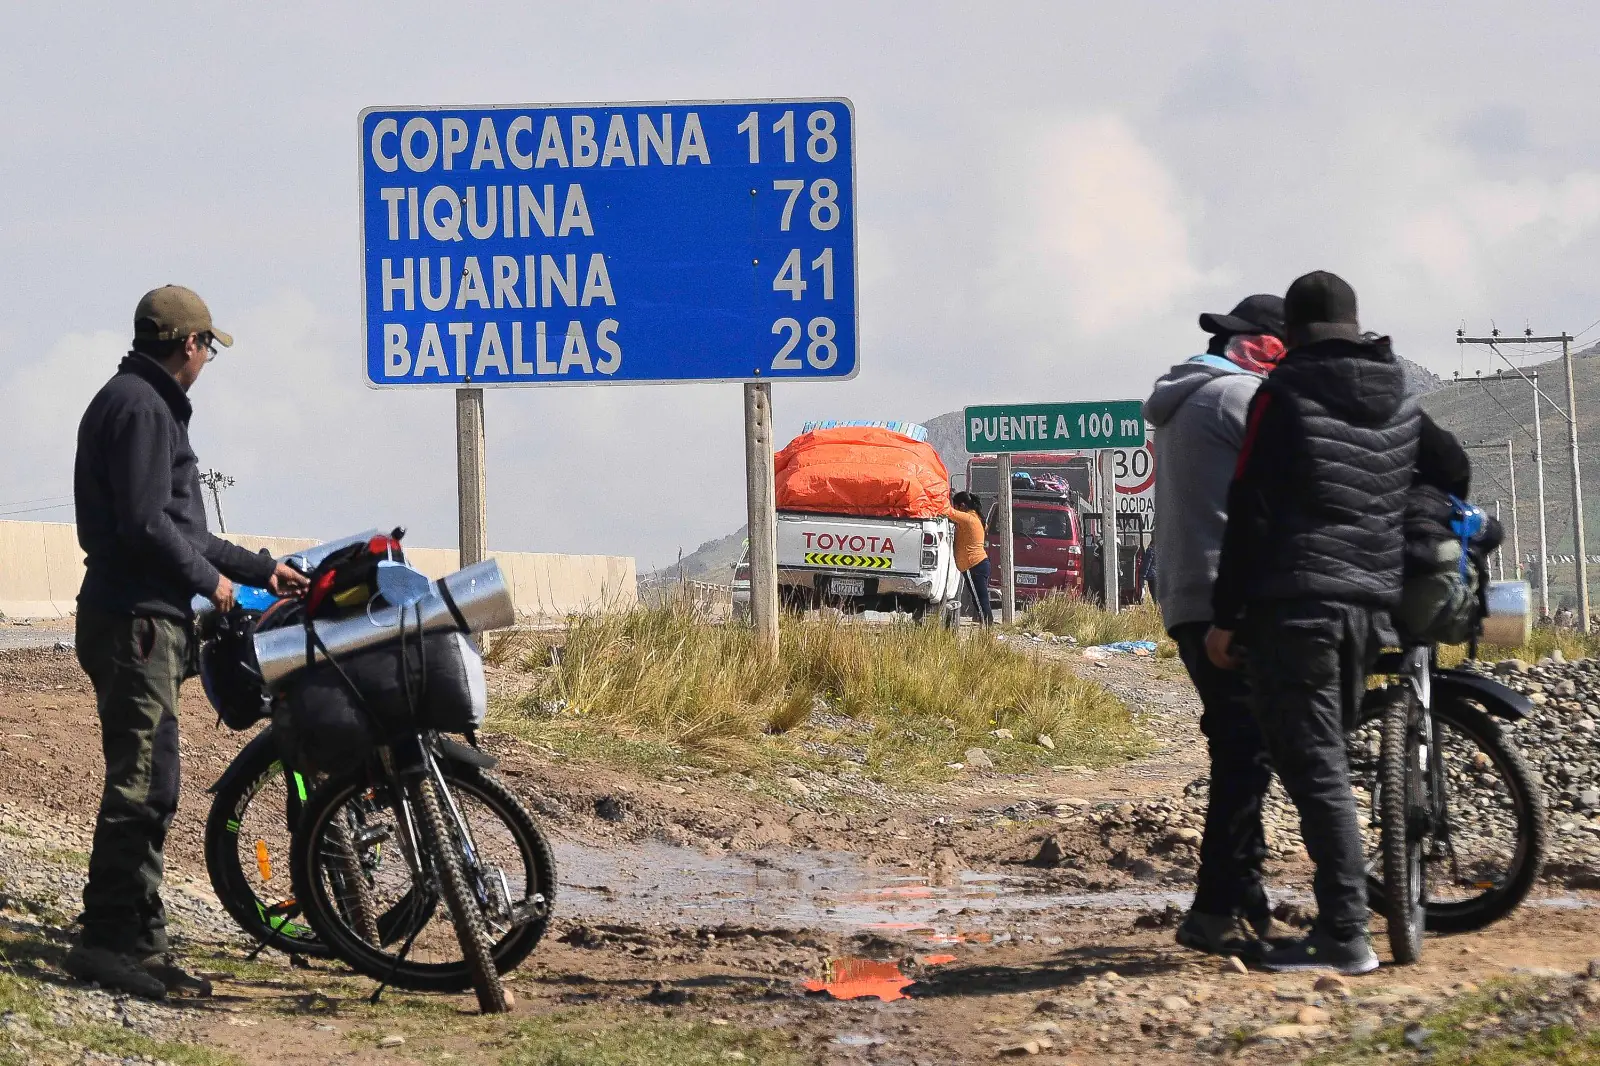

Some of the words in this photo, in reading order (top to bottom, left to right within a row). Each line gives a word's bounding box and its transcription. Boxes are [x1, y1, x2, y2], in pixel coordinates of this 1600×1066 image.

[372, 113, 711, 172] COPACABANA
[738, 110, 838, 163] 118
[381, 184, 594, 242] TIQUINA
[774, 179, 840, 231] 78
[382, 253, 616, 311] HUARINA
[773, 248, 834, 301] 41
[384, 318, 622, 376] BATALLAS
[771, 317, 838, 370] 28
[970, 415, 1048, 442] PUENTE
[1054, 414, 1070, 439] A
[1078, 412, 1114, 438] 100
[1120, 419, 1139, 436] m
[1114, 449, 1149, 478] 30
[1101, 497, 1155, 513] LOCIDA
[802, 532, 895, 554] TOYOTA
